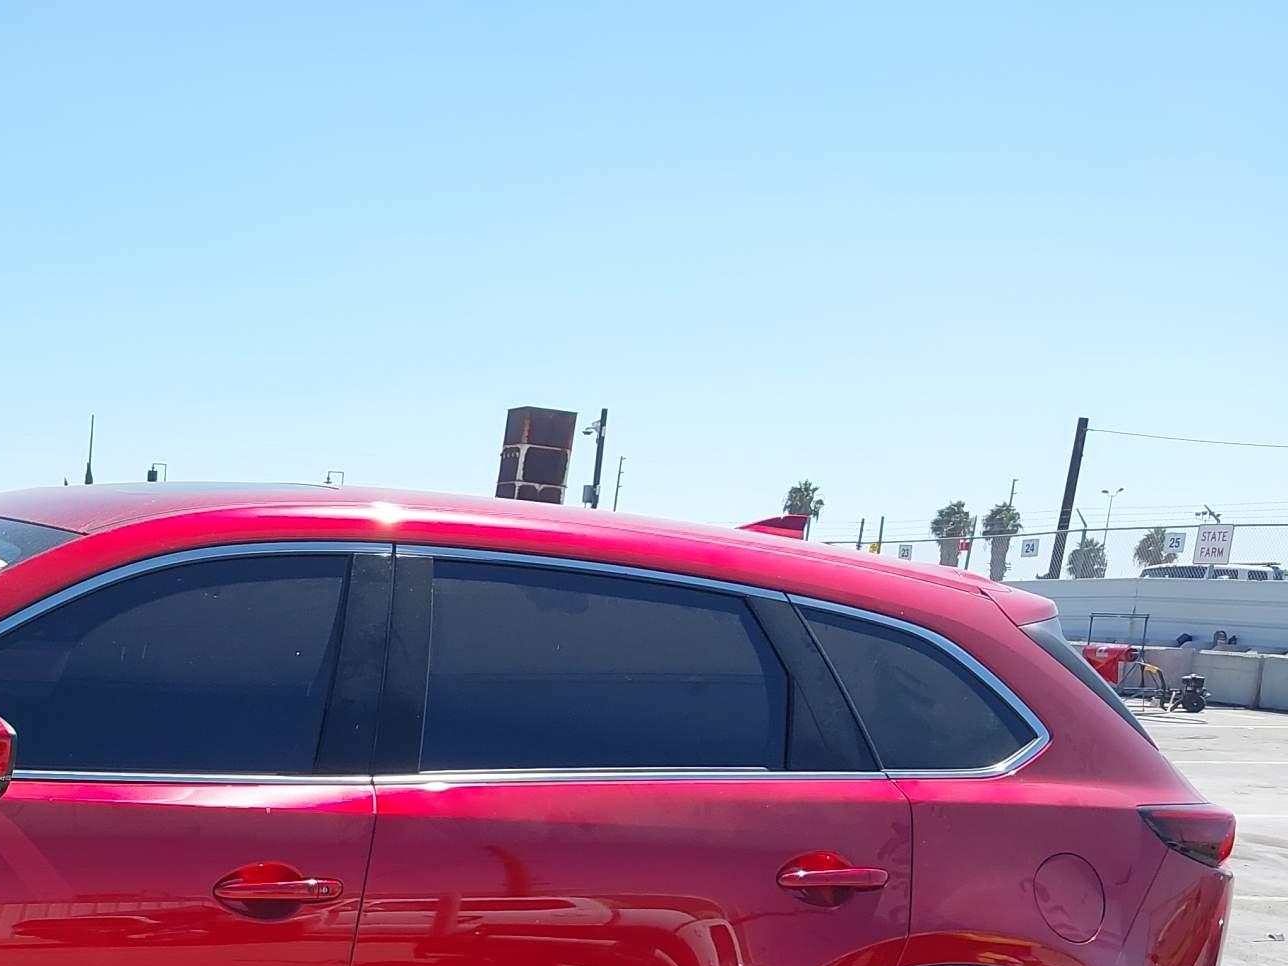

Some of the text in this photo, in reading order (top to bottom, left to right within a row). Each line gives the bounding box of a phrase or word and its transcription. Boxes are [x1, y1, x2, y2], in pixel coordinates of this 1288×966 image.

[1201, 531, 1228, 542] STATE
[1025, 543, 1035, 553] 24
[1169, 537, 1181, 549] 25
[901, 548, 910, 558] 23
[1200, 547, 1224, 558] FARM
